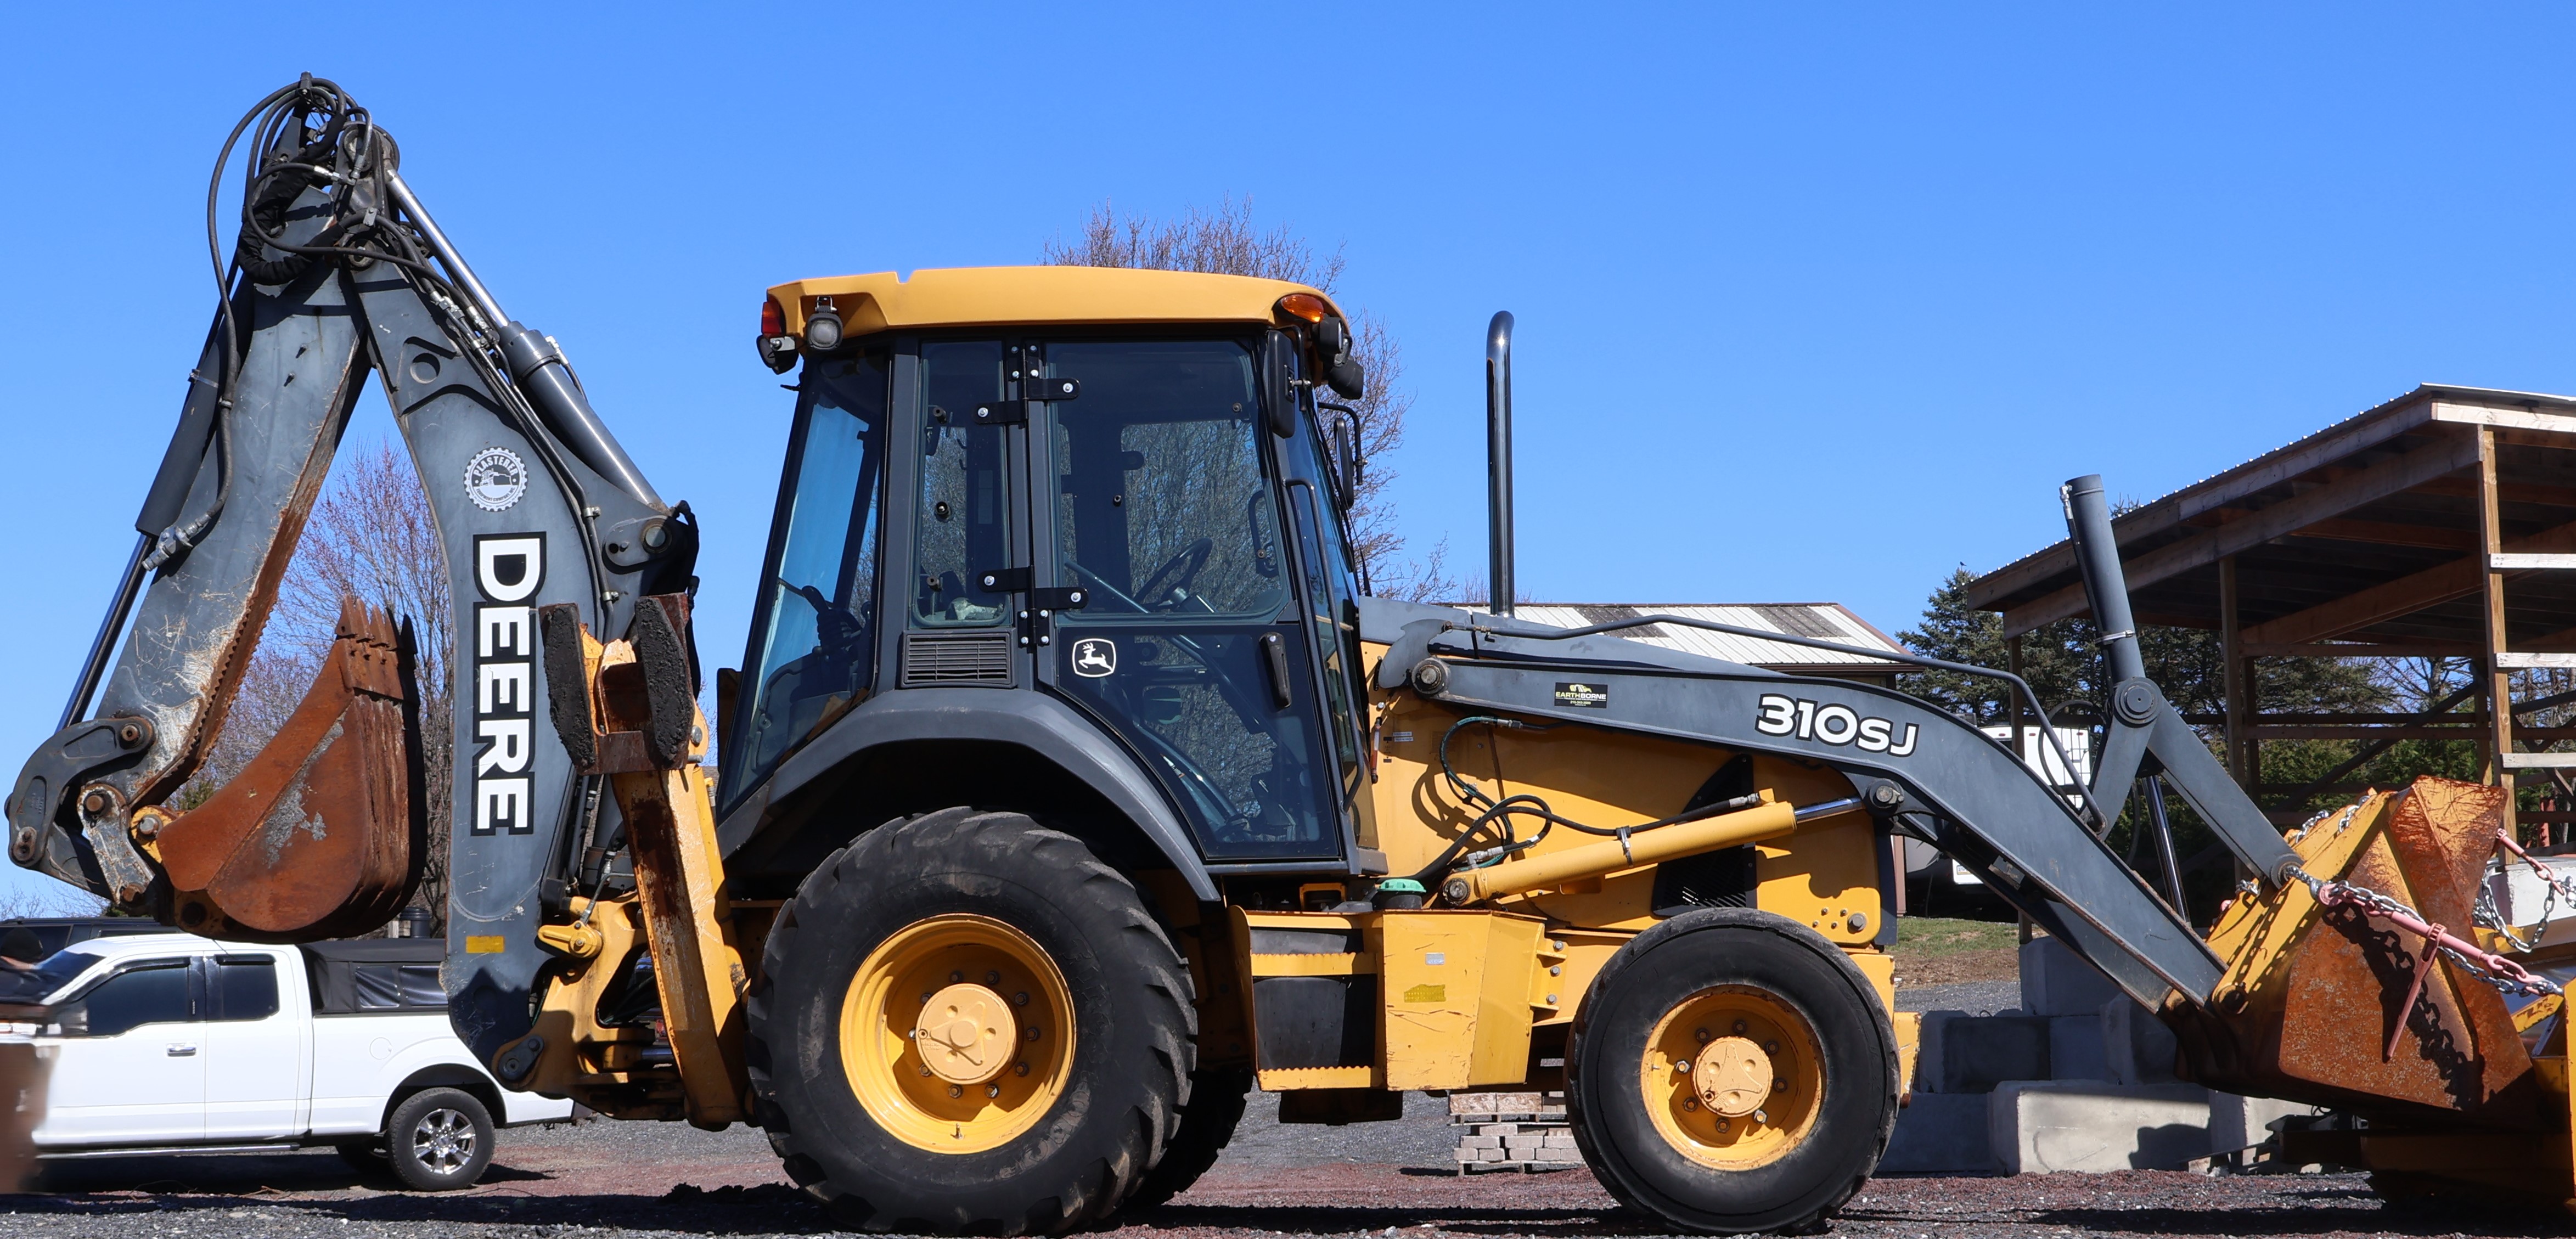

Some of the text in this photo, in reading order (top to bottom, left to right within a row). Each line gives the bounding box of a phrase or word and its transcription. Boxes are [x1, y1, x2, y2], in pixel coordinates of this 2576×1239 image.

[473, 455, 519, 477] PLASTERER
[477, 537, 542, 831] DEERE
[1555, 691, 1607, 700] EARTHBORNE
[1756, 695, 1918, 756] 310SJ
